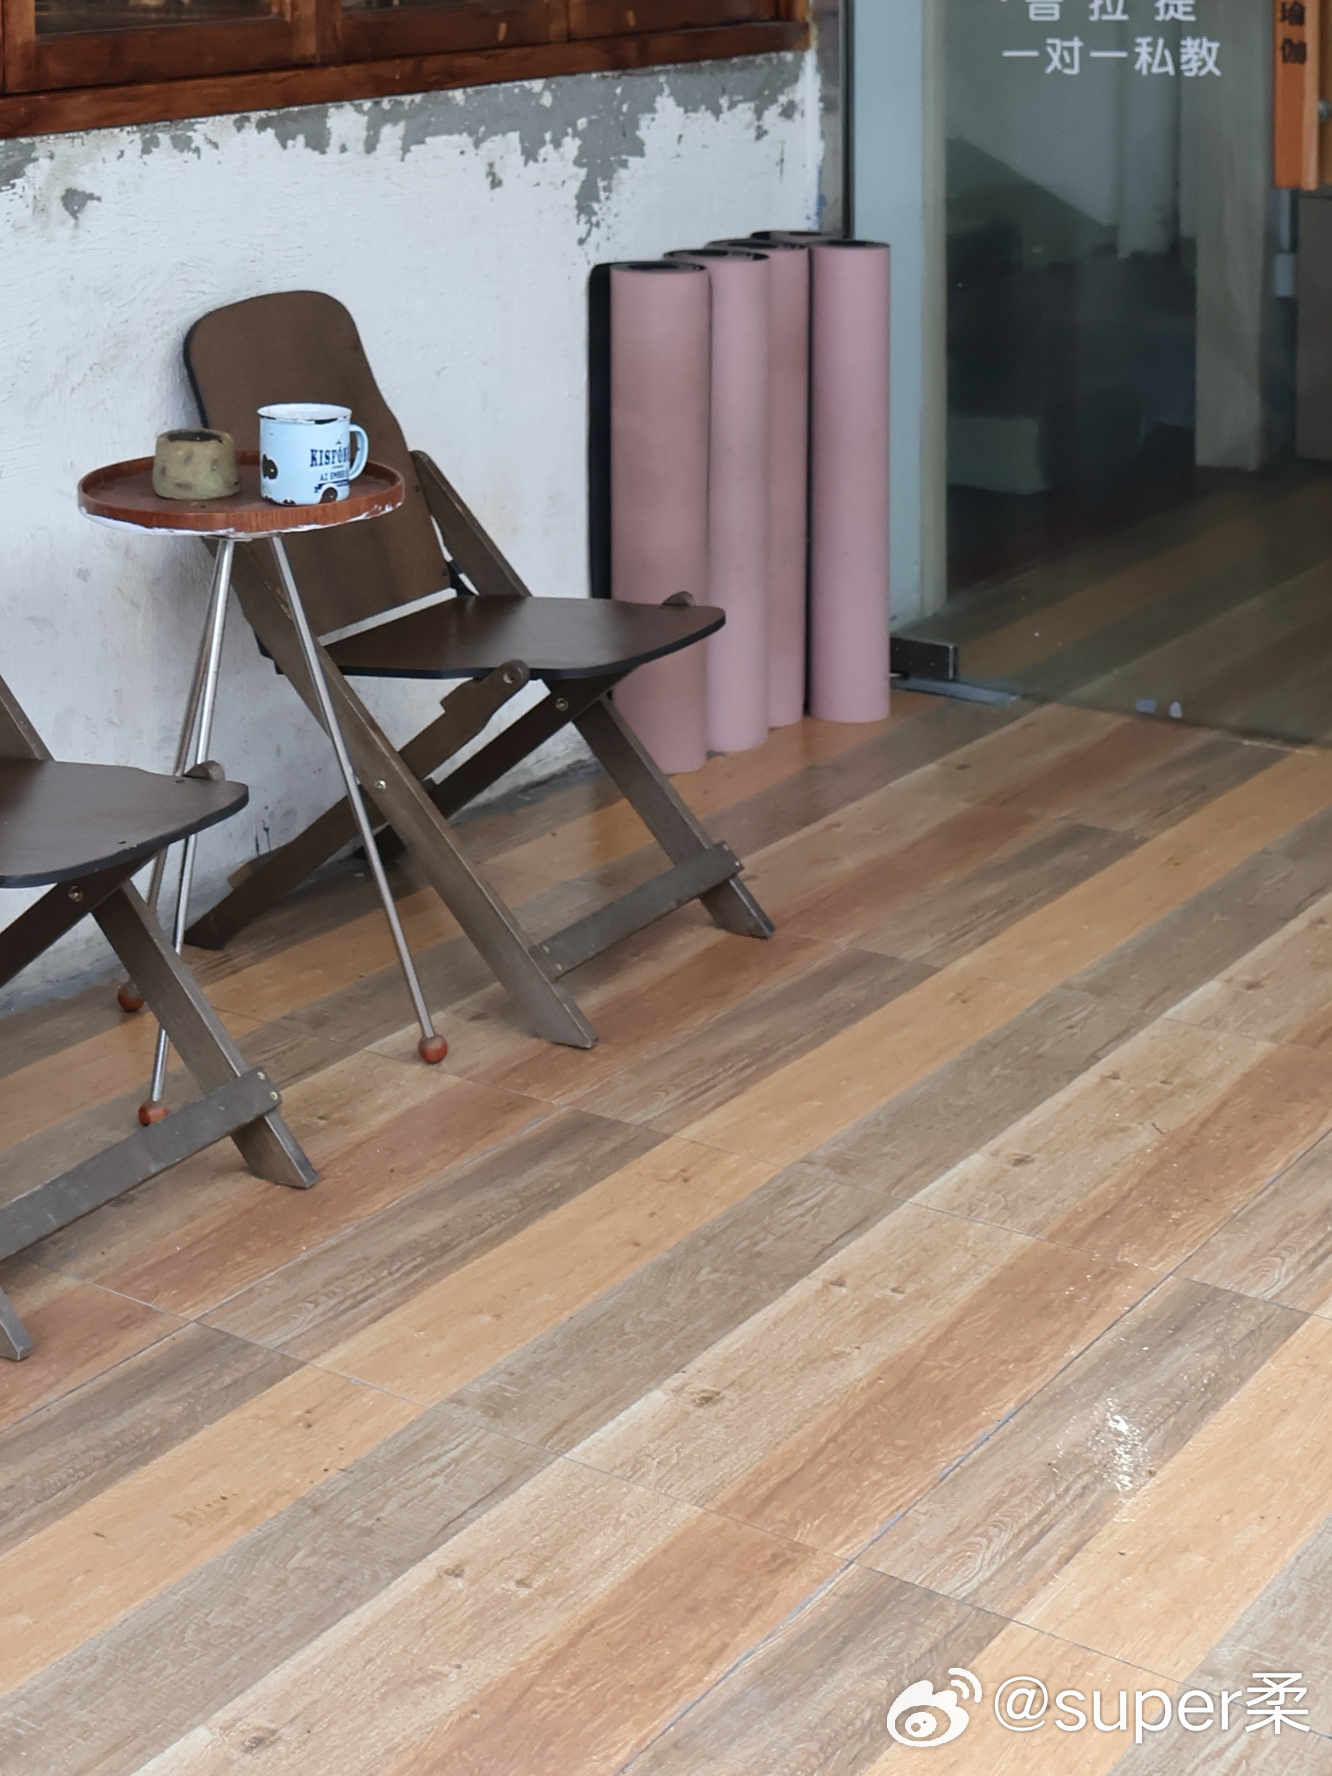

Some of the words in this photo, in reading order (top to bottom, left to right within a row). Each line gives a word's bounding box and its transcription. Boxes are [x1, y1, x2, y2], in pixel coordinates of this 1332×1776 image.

[1002, 35, 1222, 76] 一对一私教
